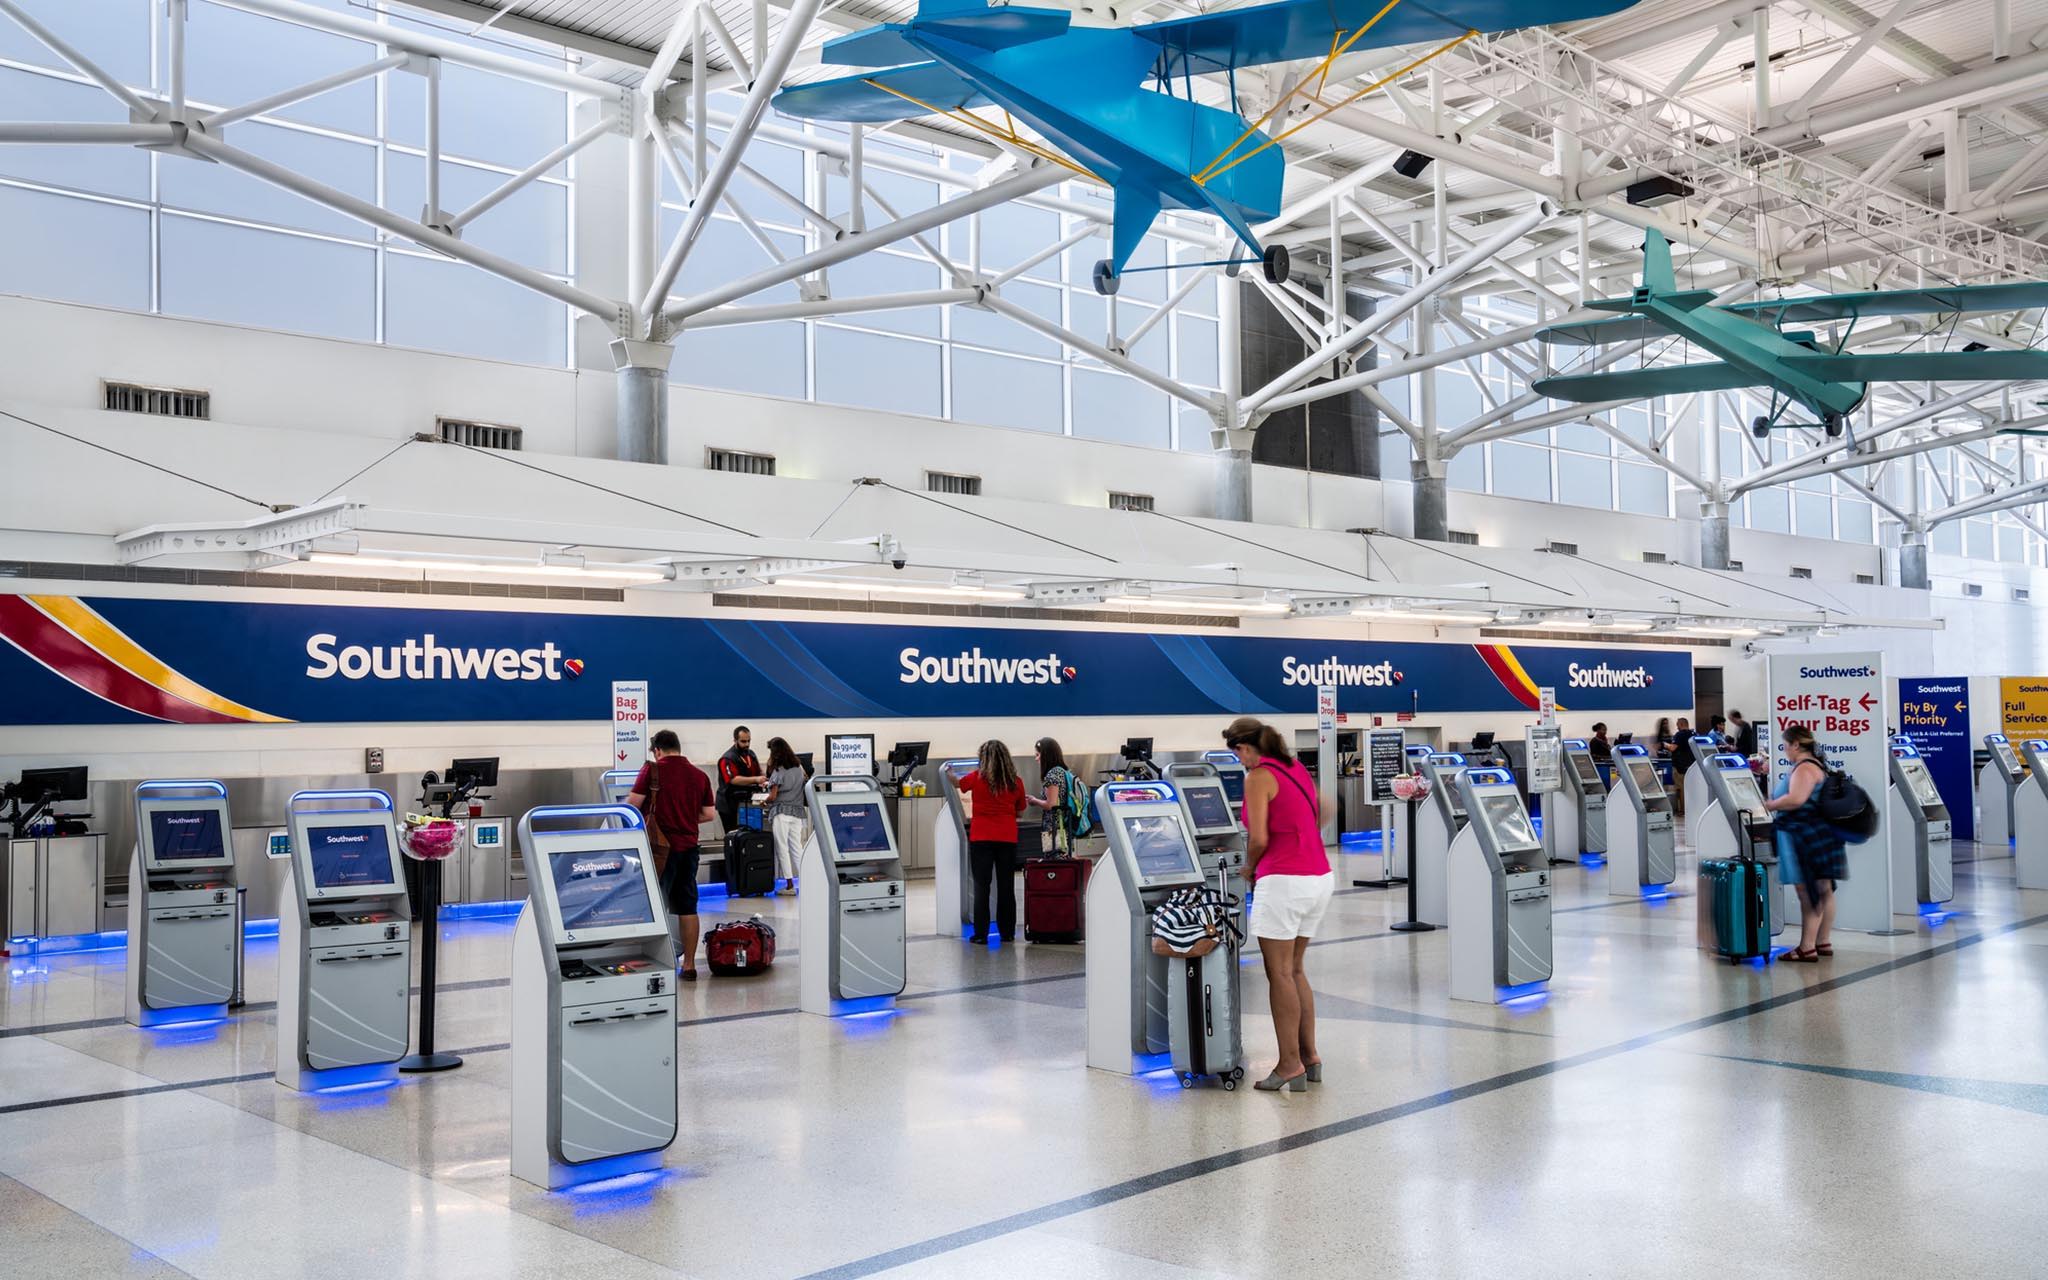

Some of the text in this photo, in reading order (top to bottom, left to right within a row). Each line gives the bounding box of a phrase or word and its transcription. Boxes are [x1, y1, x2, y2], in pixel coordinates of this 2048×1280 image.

[306, 634, 561, 680] Southwest
[900, 647, 1061, 684] Southwest
[1282, 656, 1393, 686] Southwest
[1568, 662, 1646, 688] Southwest
[1800, 666, 1869, 678] Southwest
[1918, 685, 1961, 693] Southwest
[616, 697, 638, 710] Bag
[1776, 694, 1851, 714] Self-Tag
[1903, 702, 1937, 714] Fly By
[2005, 701, 2025, 711] Full
[616, 711, 646, 723] Drop
[1321, 707, 1335, 716] Drop
[1904, 714, 1947, 726] Priority
[2005, 713, 2047, 723] Service
[1825, 716, 1870, 736] Bags
[832, 742, 861, 752] Baggage
[1839, 745, 1857, 753] pass
[832, 752, 867, 760] Allowance
[326, 835, 364, 843] Southwest
[572, 862, 616, 872] Southwest
